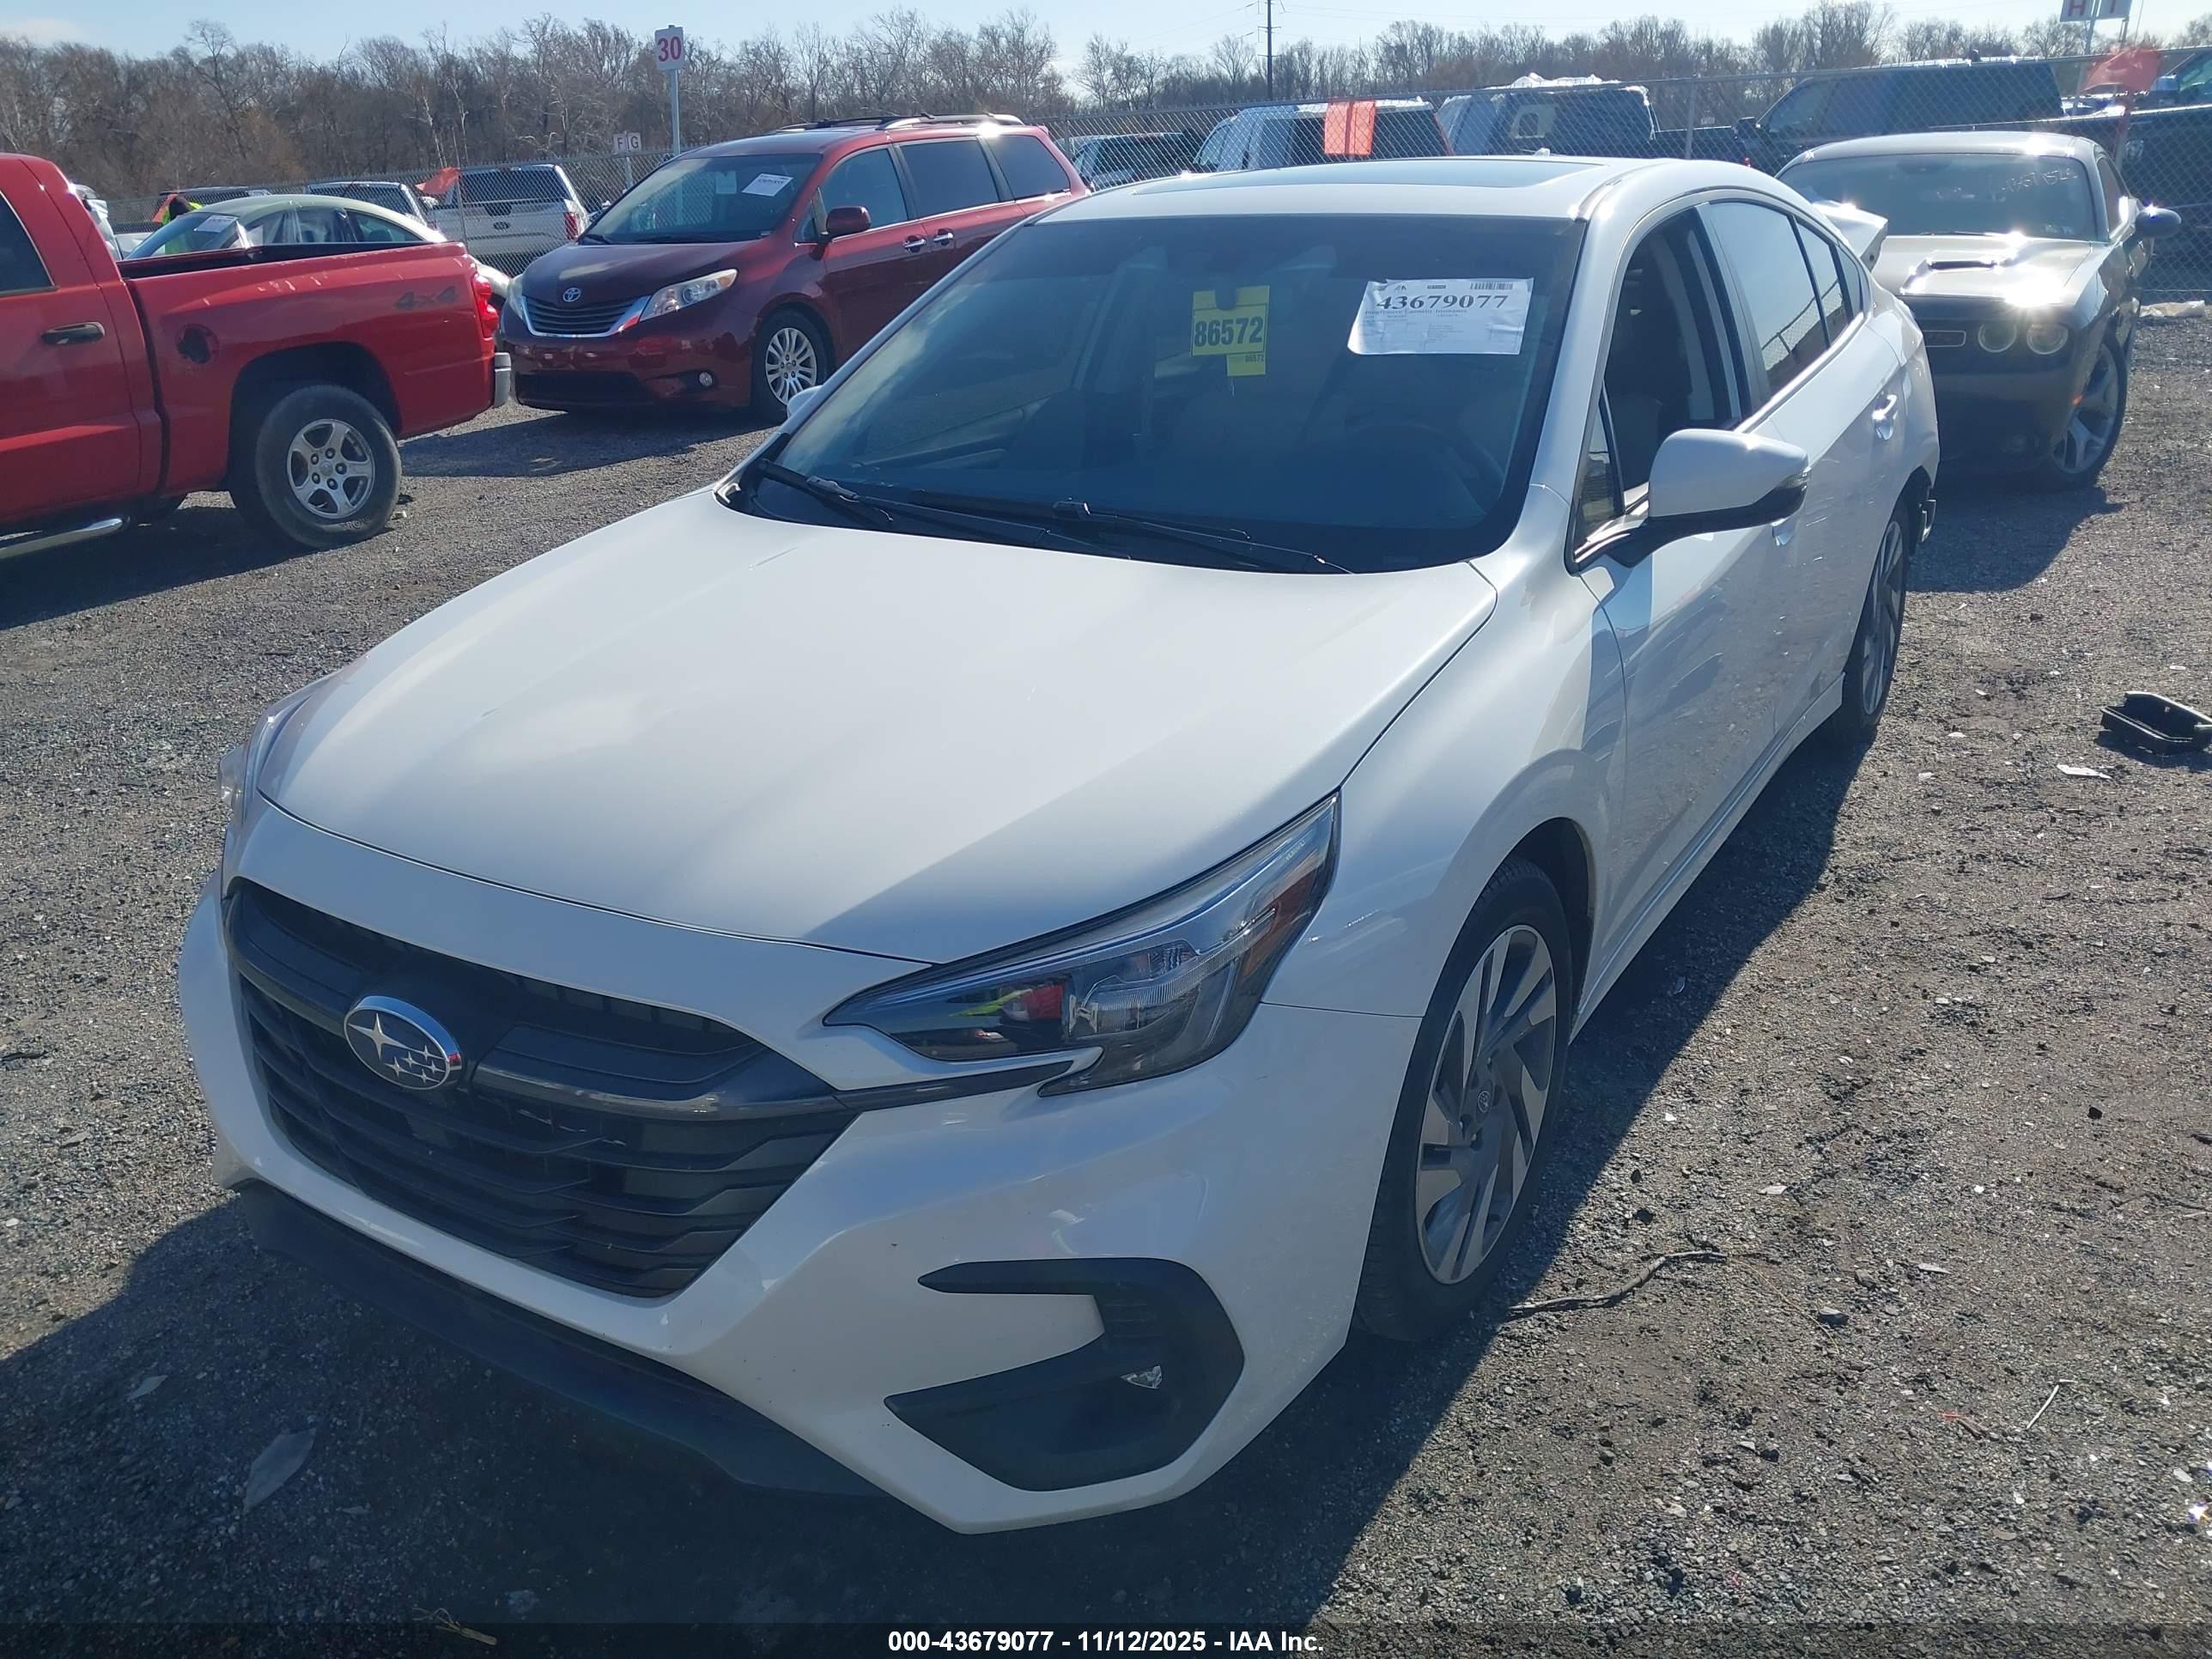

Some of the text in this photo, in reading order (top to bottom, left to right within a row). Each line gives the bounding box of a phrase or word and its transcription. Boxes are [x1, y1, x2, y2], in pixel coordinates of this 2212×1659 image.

[2067, 0, 2086, 16] H
[657, 36, 682, 62] 30
[617, 136, 639, 149] F G
[1376, 295, 1509, 310] 43679077
[1194, 316, 1263, 347] 86572
